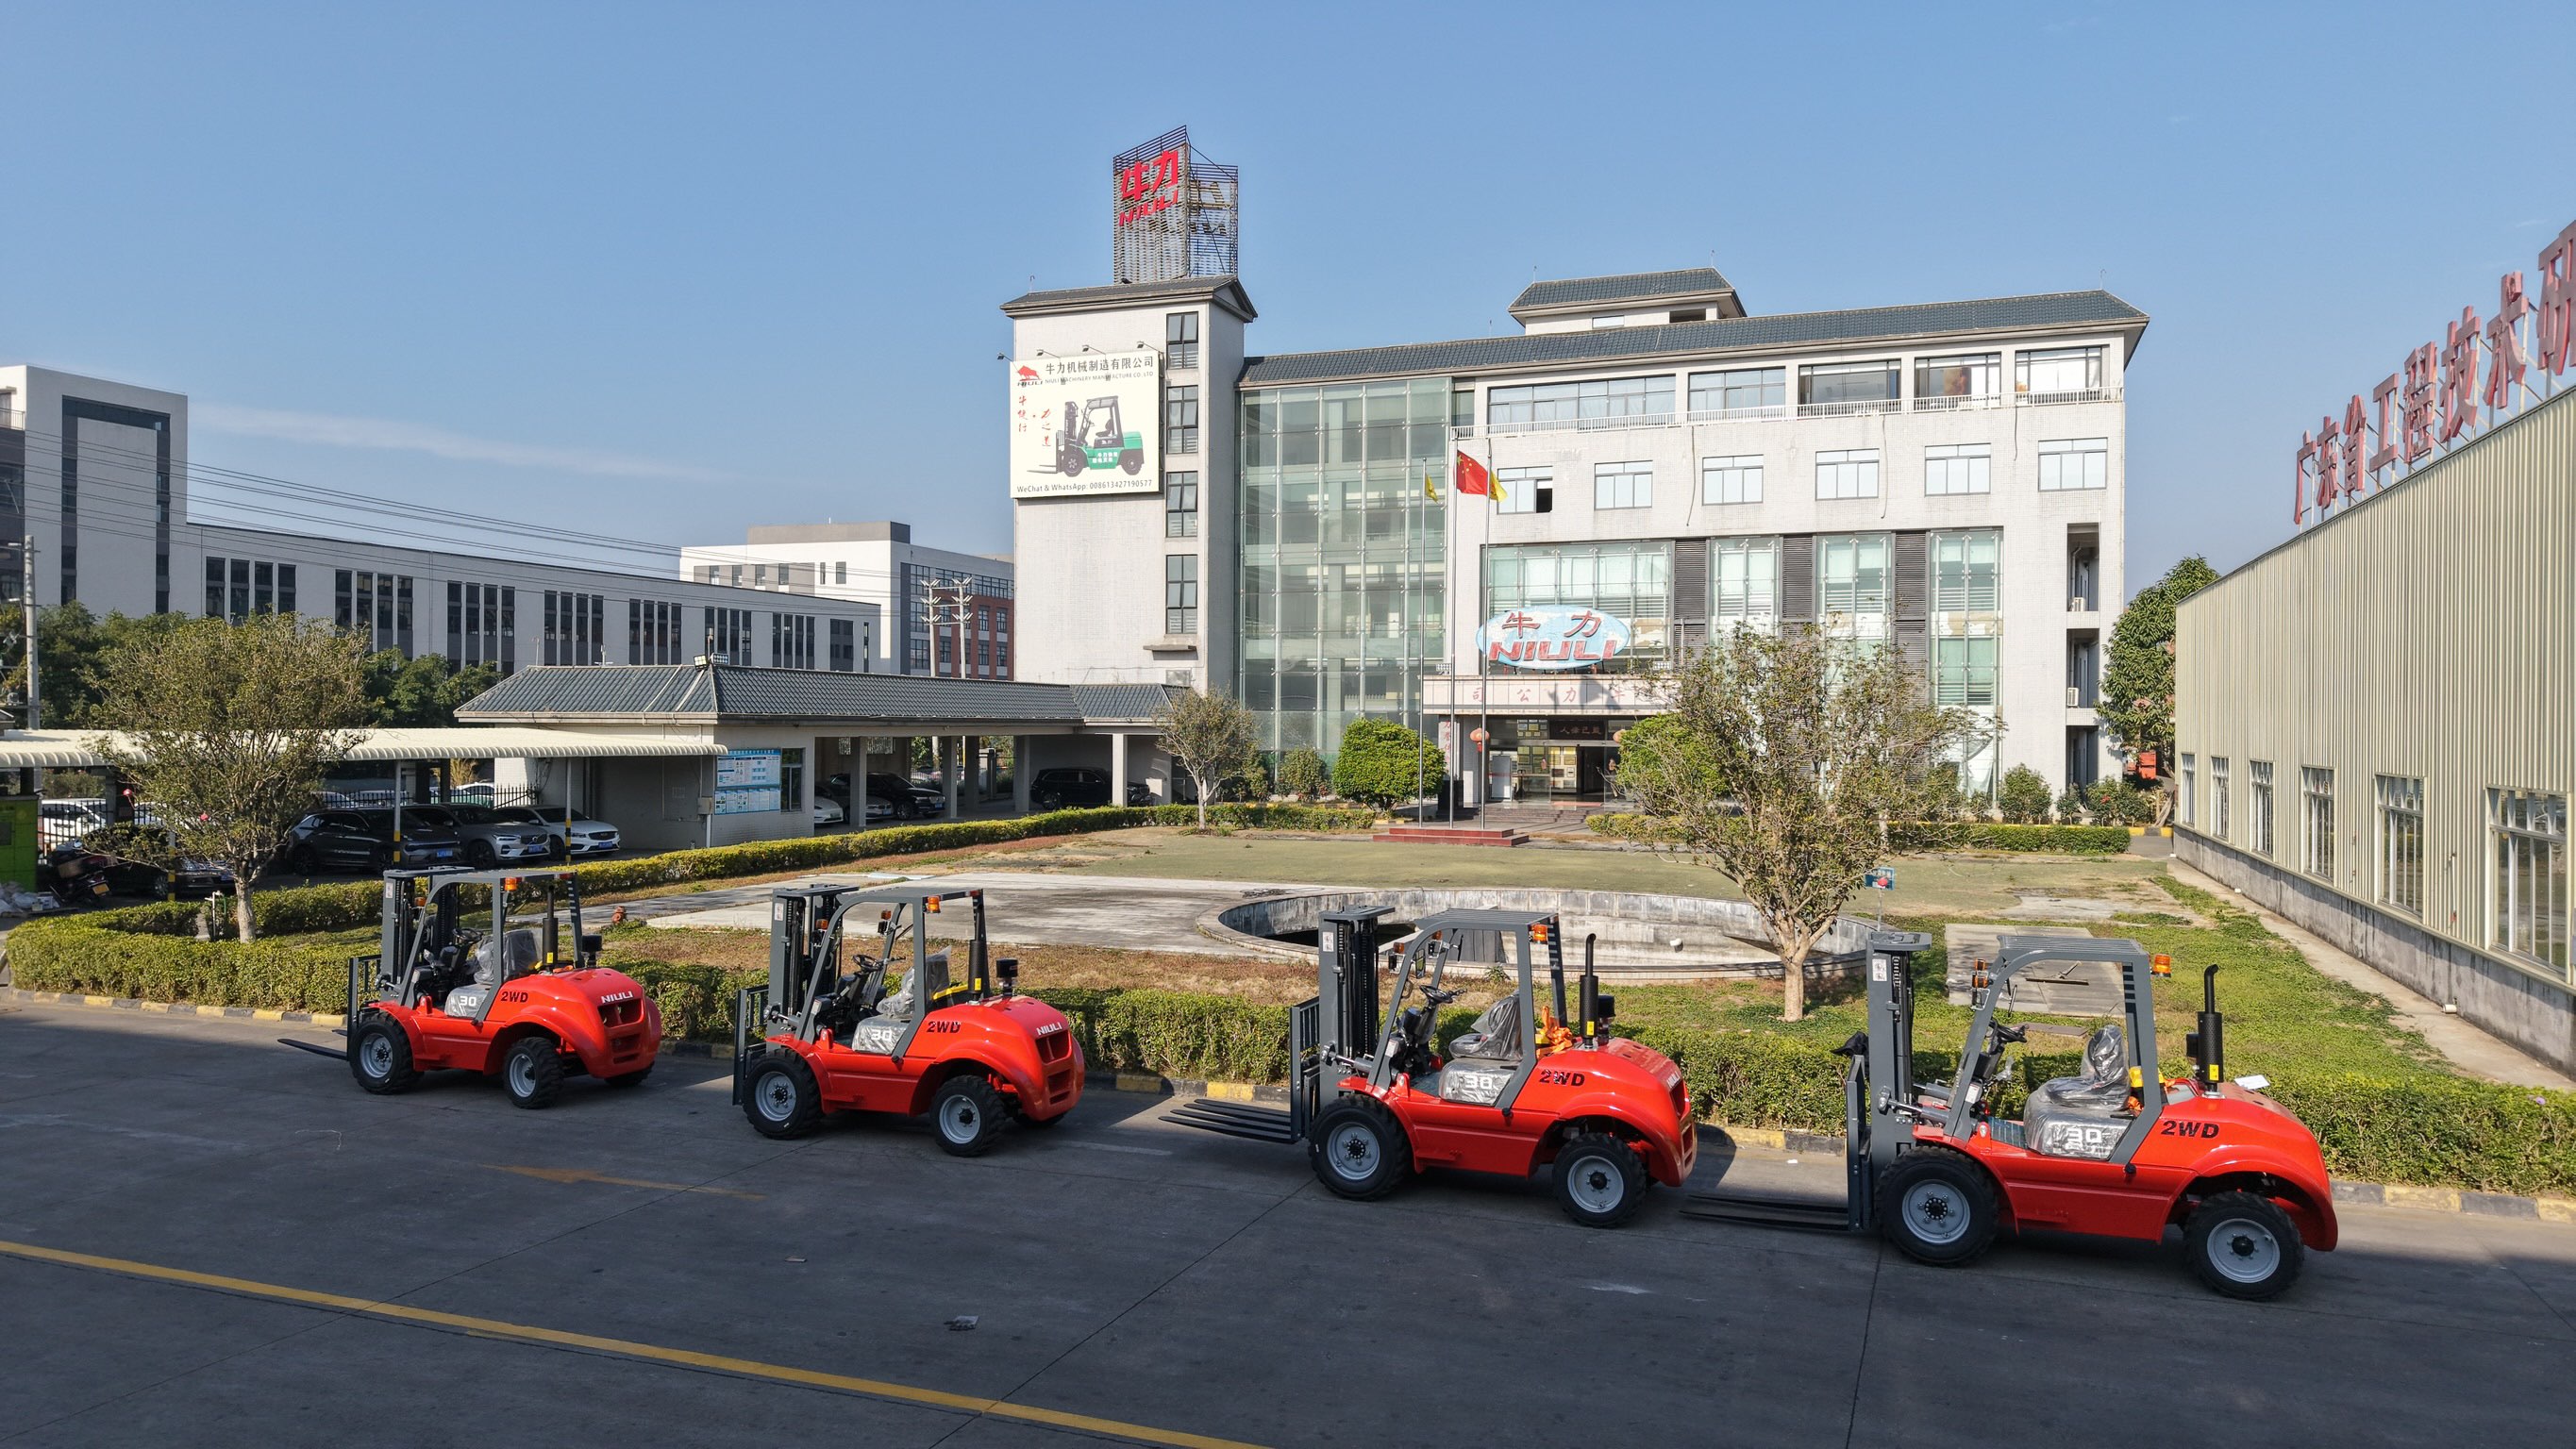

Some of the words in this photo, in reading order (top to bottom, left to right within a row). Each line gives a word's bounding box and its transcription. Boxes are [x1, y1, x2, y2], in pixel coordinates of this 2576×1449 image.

[1121, 150, 1179, 202] 牛力
[1118, 190, 1179, 226] NIULI
[1045, 357, 1153, 375] 牛力机械制造有限公司
[1090, 479, 1152, 490] 008613427190577
[1501, 609, 1602, 639] 牛力
[1488, 640, 1617, 661] NIULI
[460, 995, 477, 1007] 30
[500, 991, 528, 1003] 2WD
[600, 991, 633, 1004] NIULI
[871, 1028, 892, 1041] 30
[927, 1021, 961, 1033] 2WD
[1036, 1023, 1062, 1036] NIULI
[1539, 1069, 1585, 1087] 2WD
[2161, 1120, 2219, 1139] 2WD
